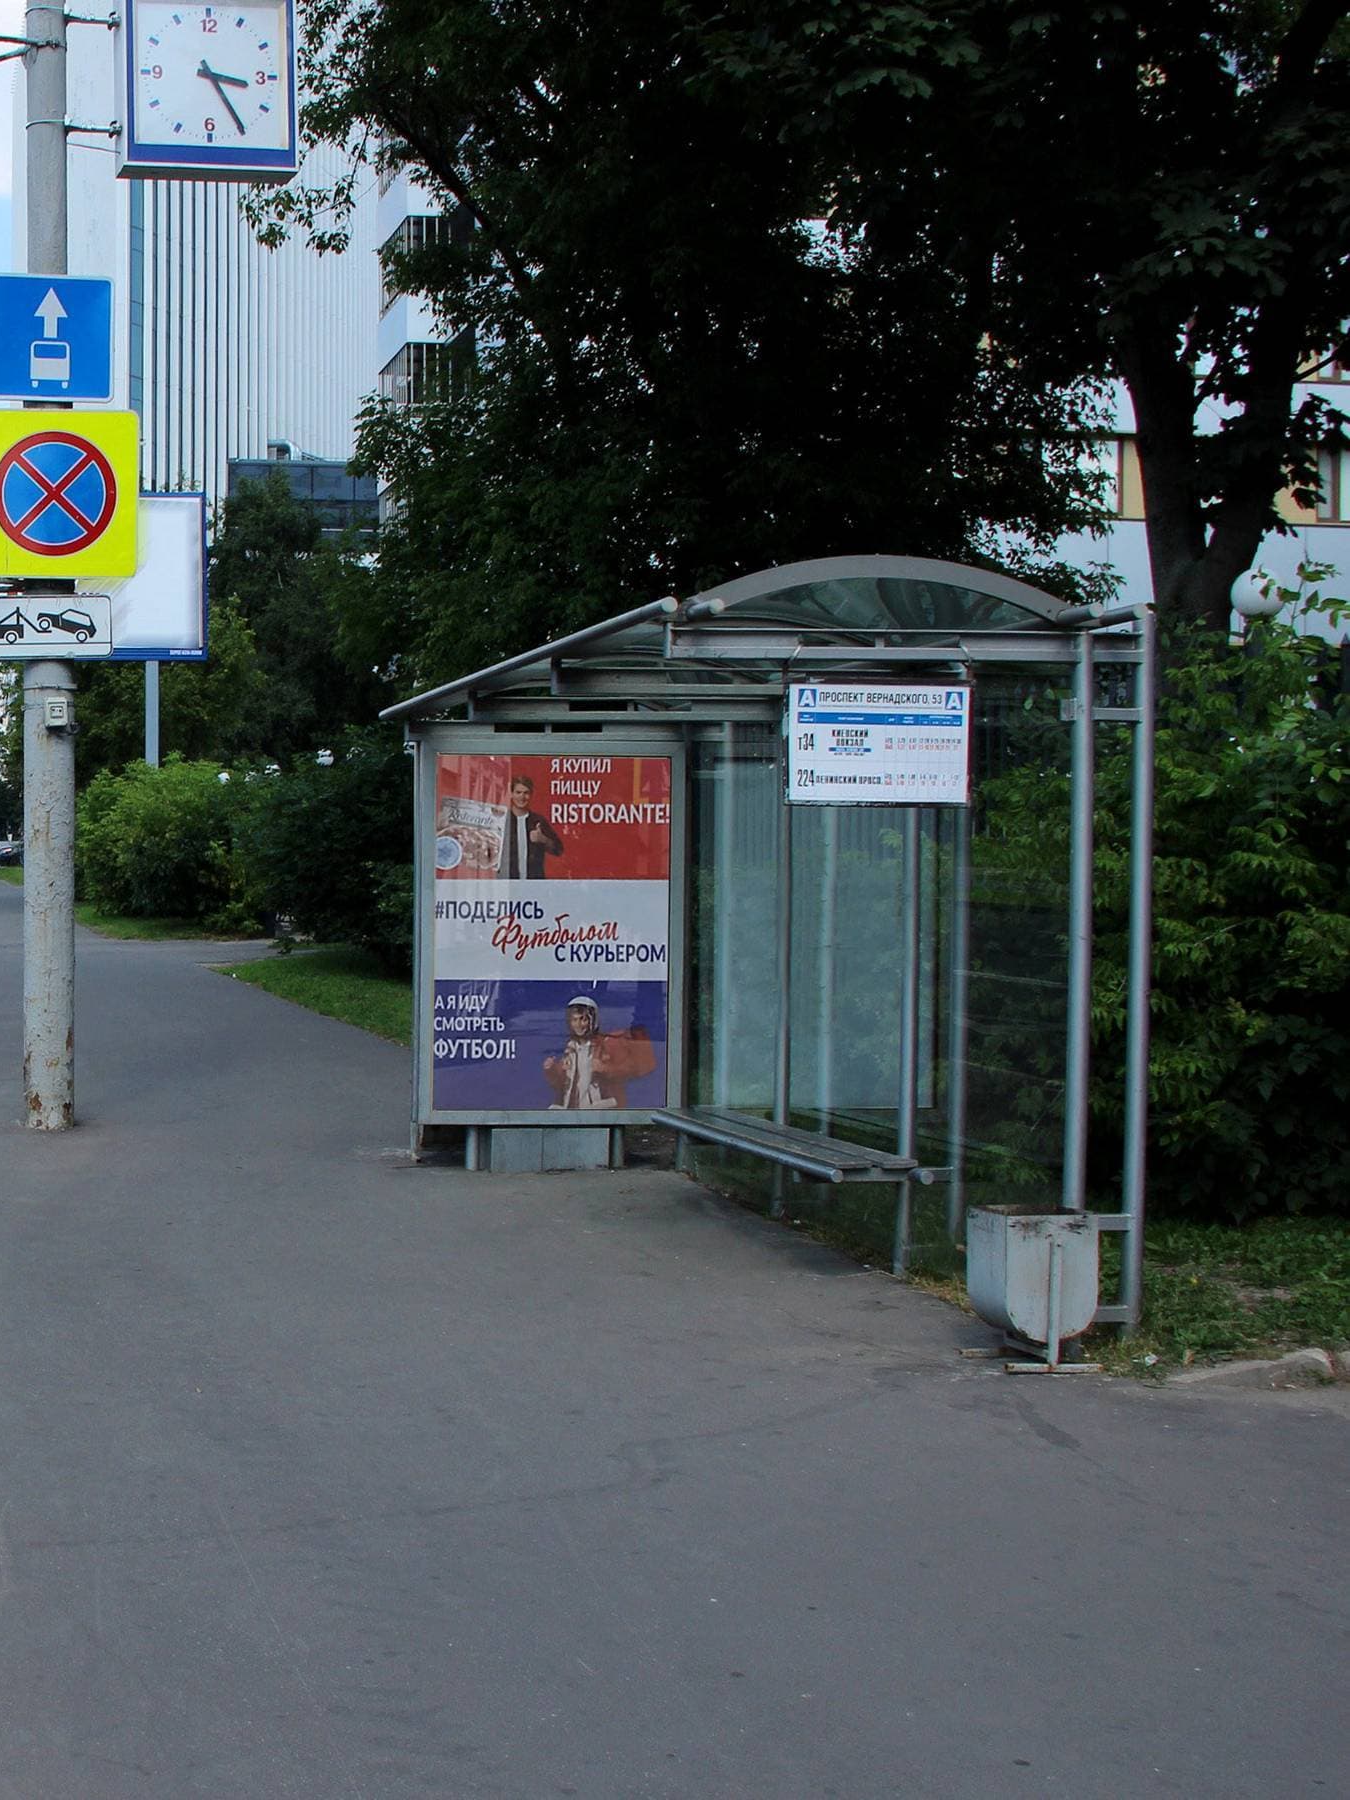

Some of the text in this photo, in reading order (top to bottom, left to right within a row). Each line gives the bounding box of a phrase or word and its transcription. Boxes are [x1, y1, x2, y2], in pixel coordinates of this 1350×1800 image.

[201, 19, 217, 33] 12
[152, 65, 162, 79] 9
[255, 71, 266, 85] 3
[204, 117, 215, 132] 6
[799, 690, 815, 706] А
[819, 691, 865, 702] ПРОСПЕКТ
[932, 694, 942, 704] 53
[946, 693, 962, 709] А
[832, 729, 869, 737] КИЕВСКИЙ
[550, 759, 611, 773] Я КУПИЛ
[797, 769, 814, 787] 224
[551, 780, 601, 798] ПИЦЦУ
[551, 803, 670, 824] RISTORANTE!
[435, 901, 544, 922] #ПОДЕЛИСЬ
[492, 914, 619, 960] Футболом
[554, 944, 666, 962] С КУРЬЕРОМ
[434, 995, 489, 1012] А Я ИДУ
[434, 1016, 505, 1031] СМОТРЕТЬ
[434, 1038, 516, 1059] ФУТБОЛ!
